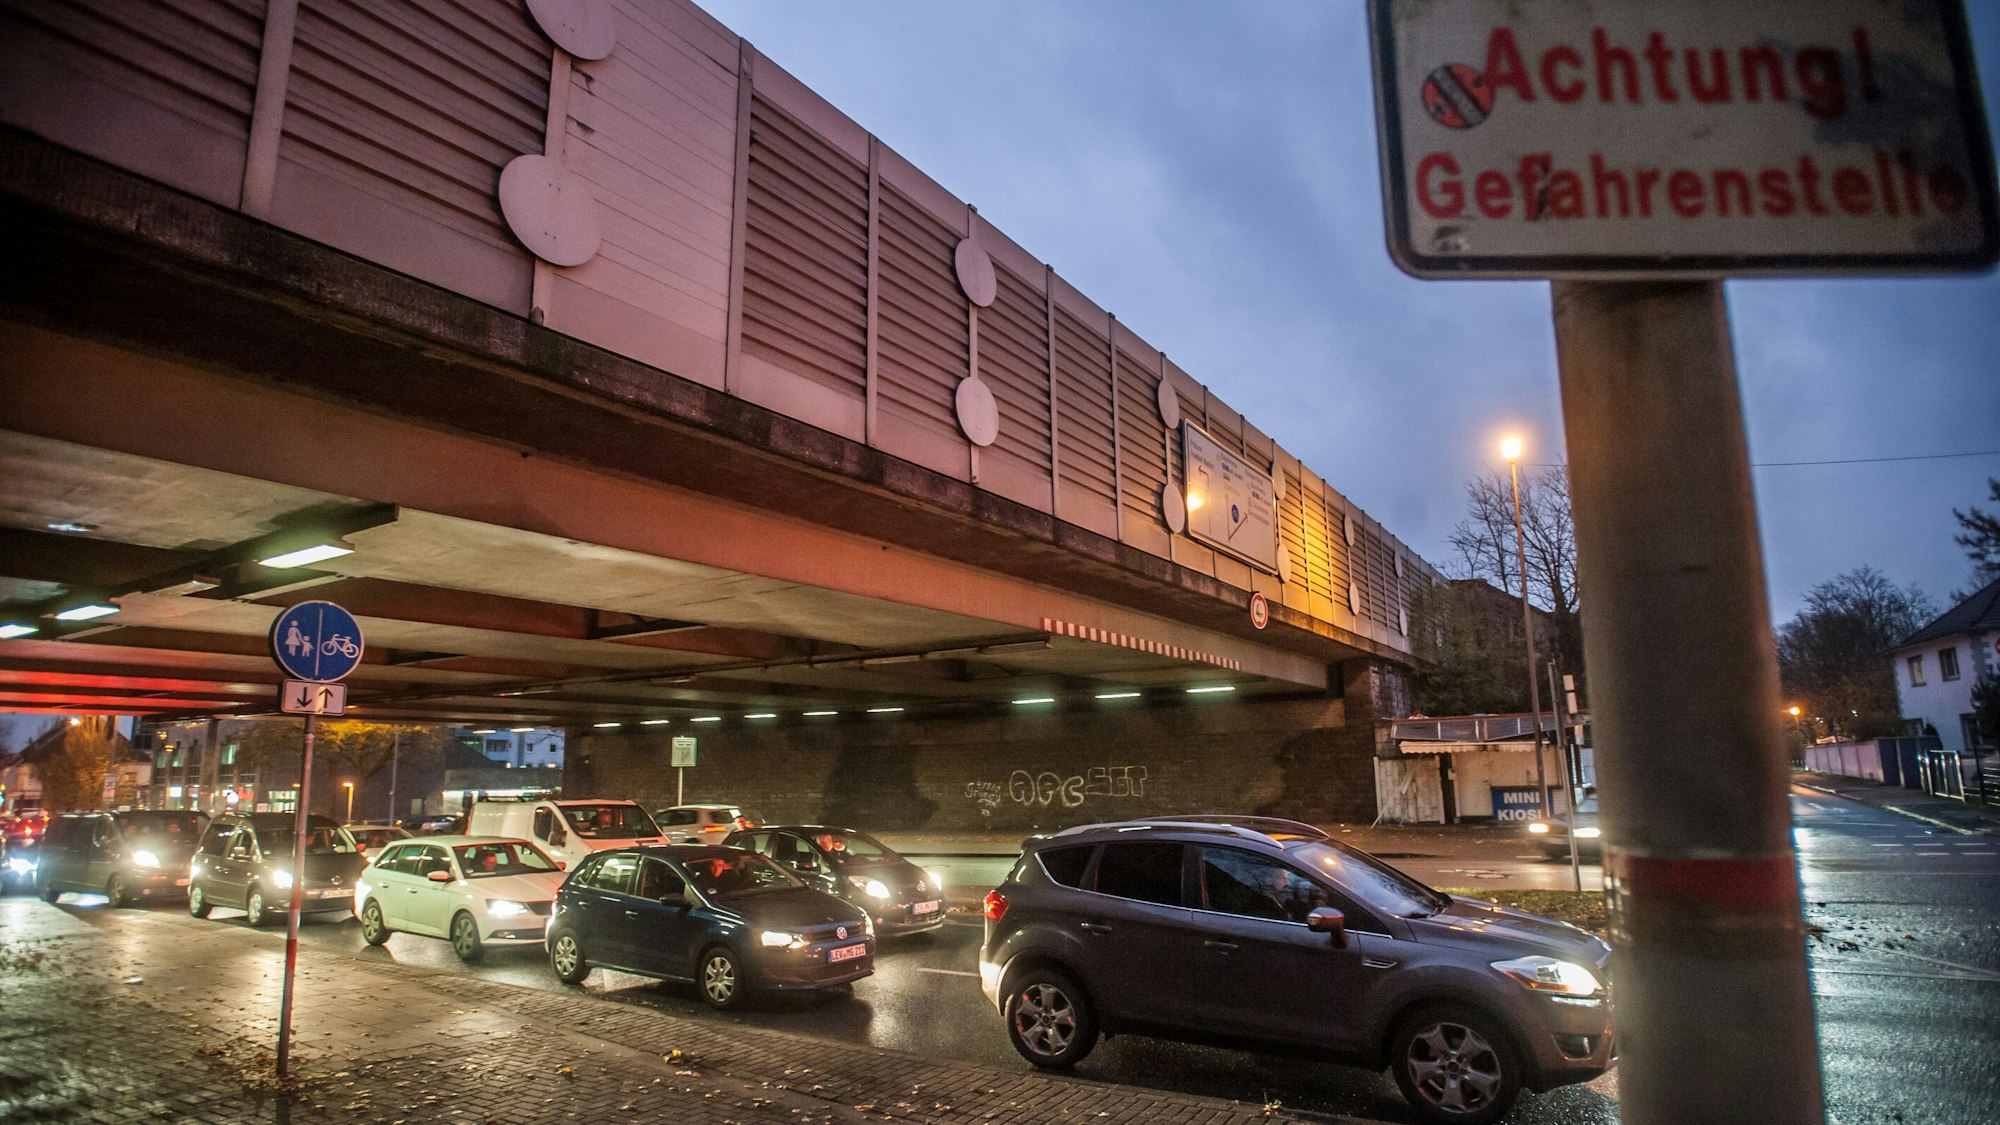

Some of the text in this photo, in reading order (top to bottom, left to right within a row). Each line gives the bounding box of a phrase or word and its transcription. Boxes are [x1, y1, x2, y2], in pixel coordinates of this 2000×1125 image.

[1481, 26, 1884, 120] Achtung!
[1414, 149, 1970, 220] Gefahrenstelle
[1503, 792, 1541, 804] MINI
